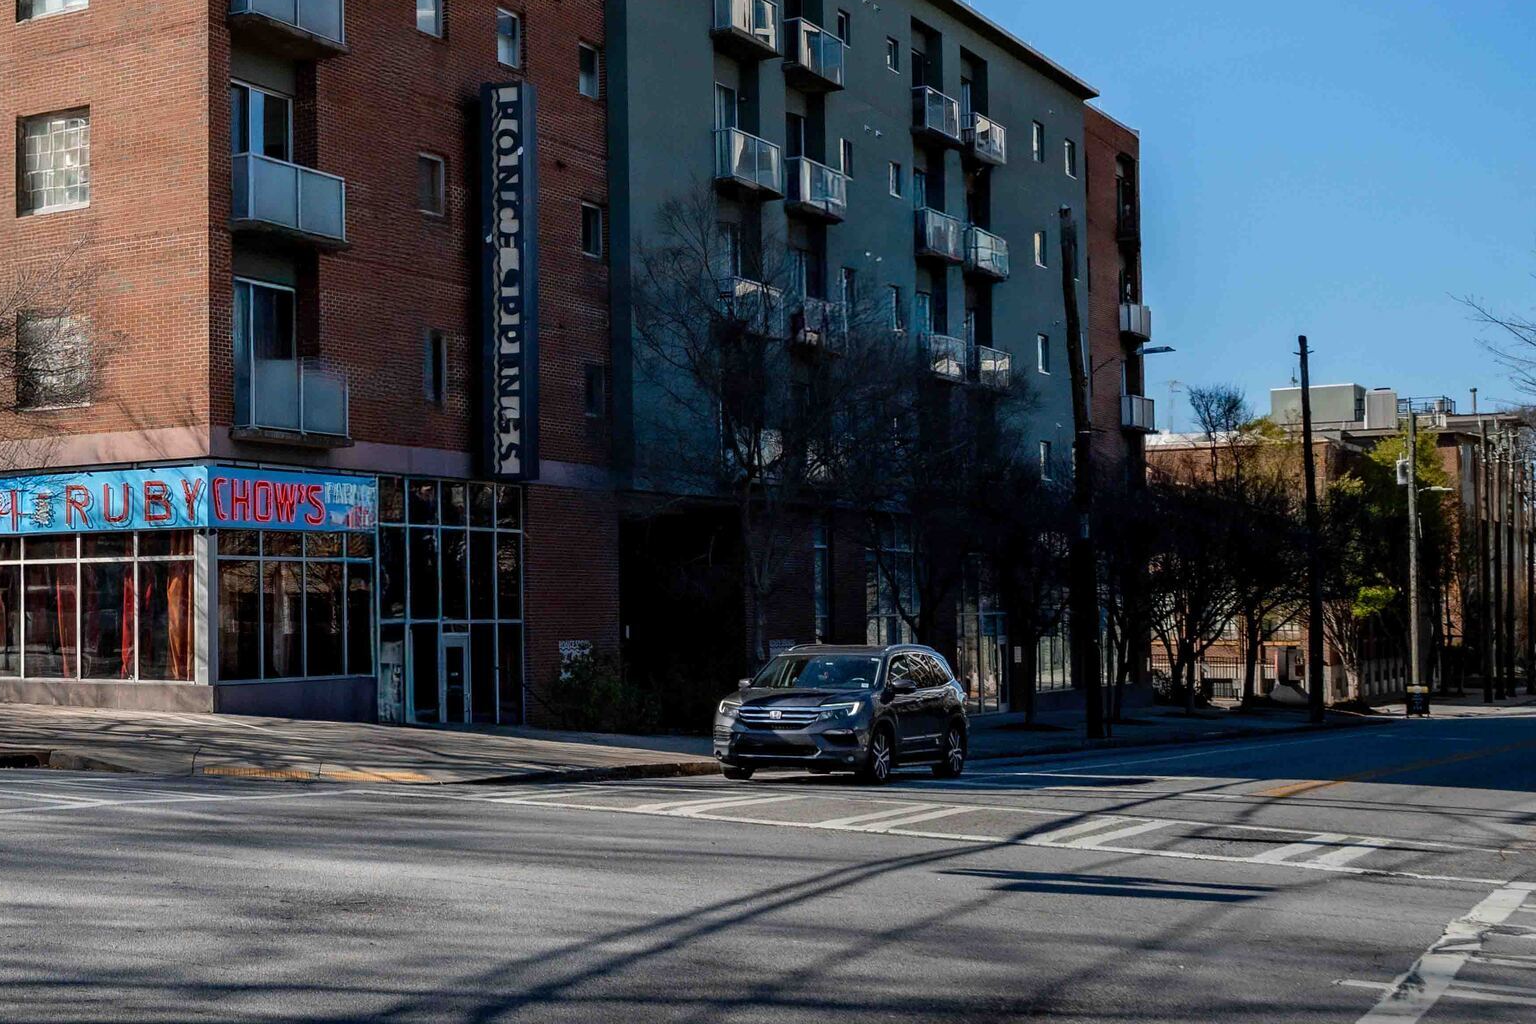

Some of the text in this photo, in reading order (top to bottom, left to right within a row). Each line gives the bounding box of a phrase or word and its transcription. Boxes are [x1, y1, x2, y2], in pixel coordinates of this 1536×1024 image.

[495, 102, 521, 248] PONCE
[66, 478, 206, 528] RUBY
[213, 476, 326, 525] CHOW'S
